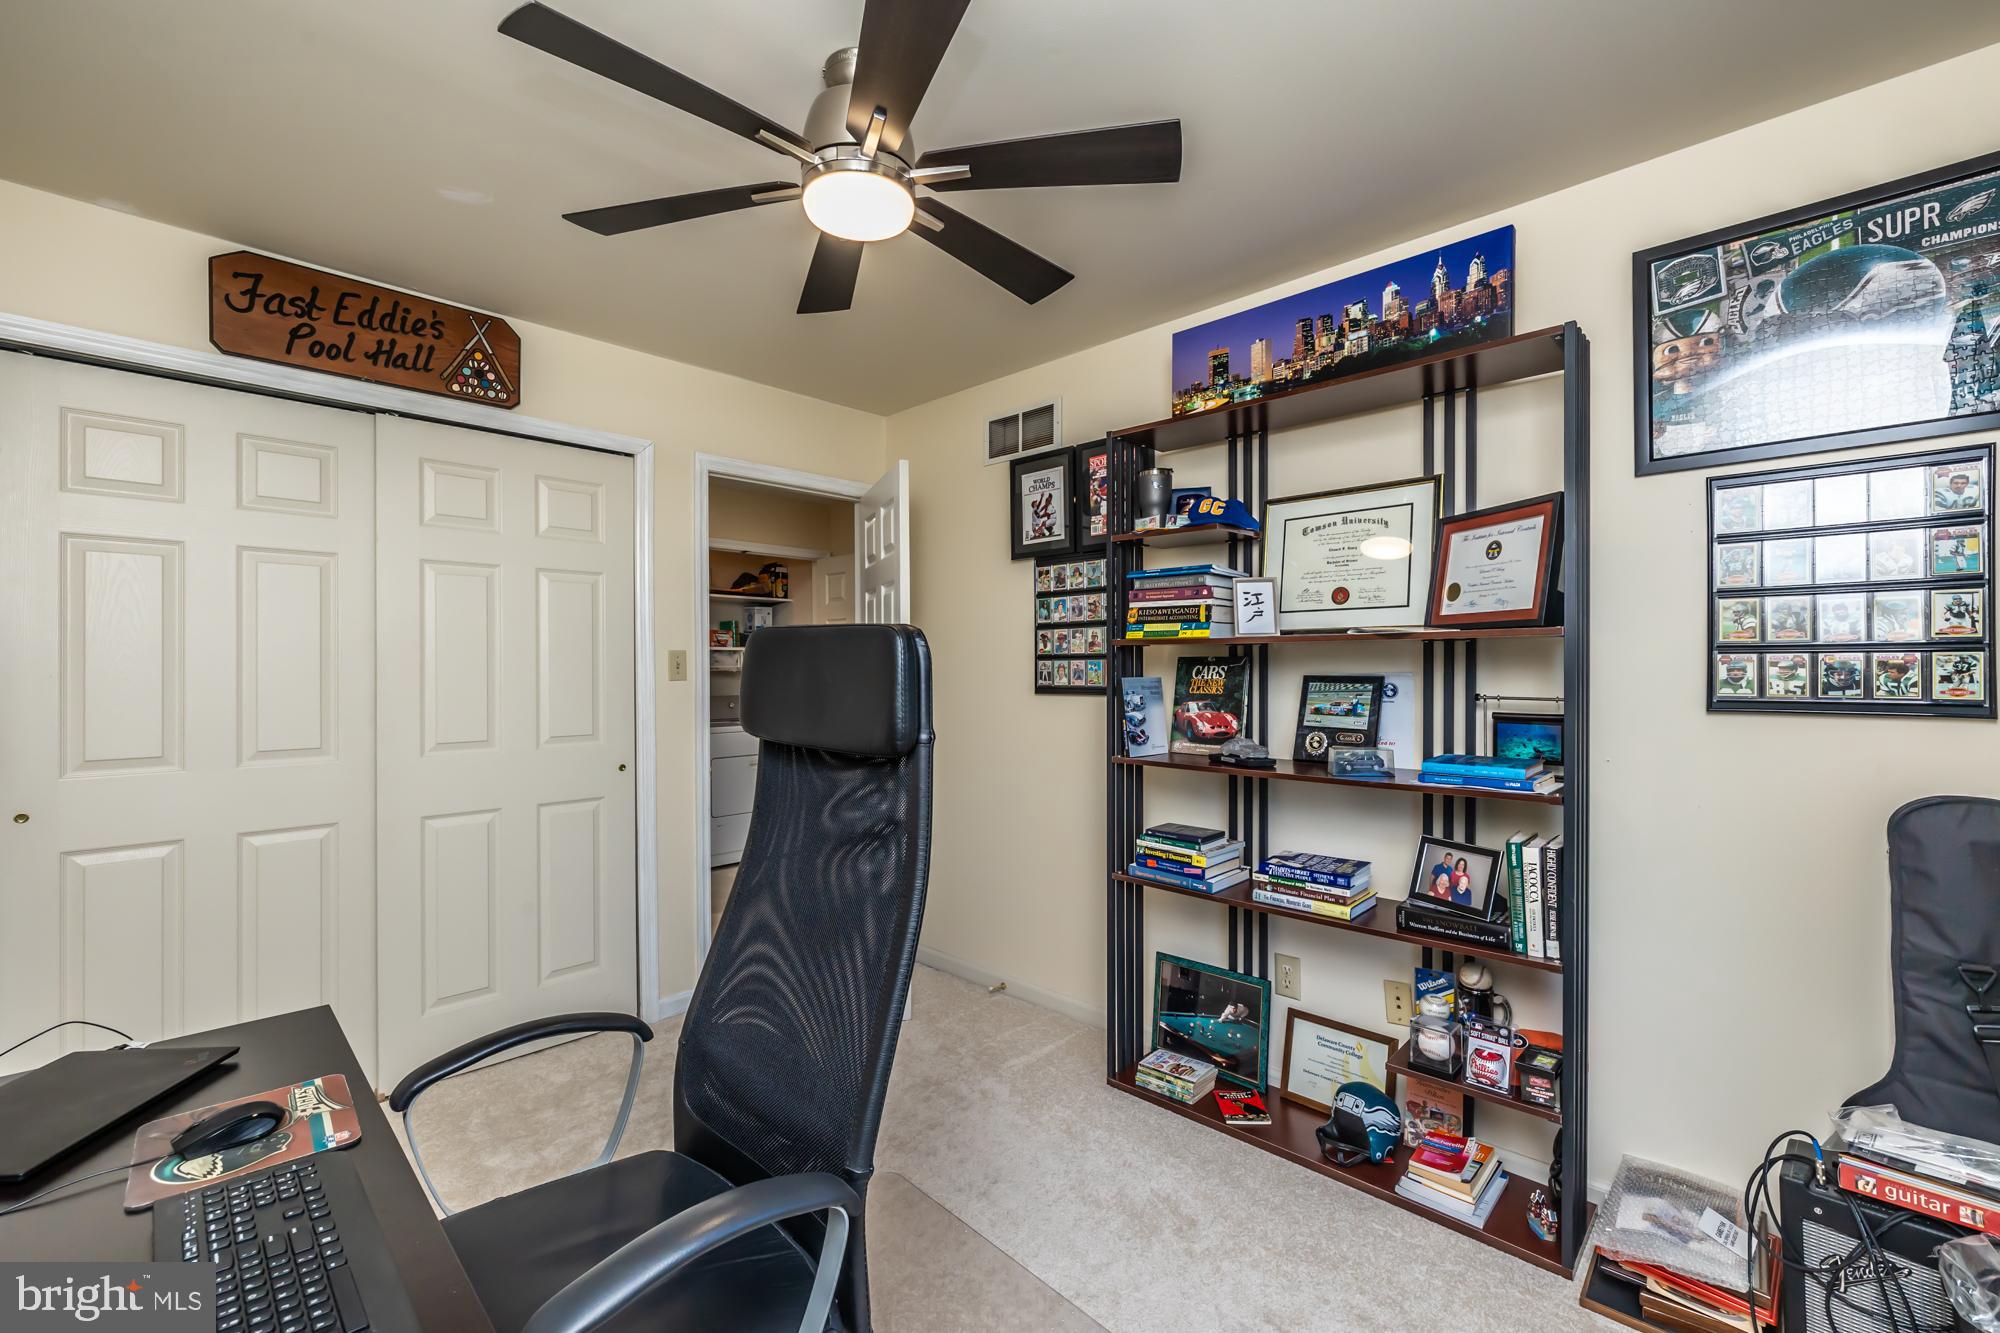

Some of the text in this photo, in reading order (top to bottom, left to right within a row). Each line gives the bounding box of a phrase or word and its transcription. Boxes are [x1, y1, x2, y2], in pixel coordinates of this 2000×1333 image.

[1788, 221, 1834, 242] PHILADELPHIA
[1867, 202, 1941, 244] SUPR
[1791, 219, 1854, 256] EAGLES
[1921, 221, 2000, 247] CHAMPION
[224, 271, 446, 340] Fast Eddie's
[285, 323, 436, 373] Pool Hall
[1029, 481, 1056, 493] CHAMPS
[1033, 476, 1051, 484] WORLD
[1198, 498, 1227, 516] GC
[1341, 516, 1389, 528] University
[1192, 665, 1228, 679] CARS
[1189, 686, 1225, 694] CLASSICS
[1145, 848, 1167, 859] Investing
[1269, 865, 1276, 875] 7
[1547, 848, 1557, 908] HIGHLY CONFIDENT
[1528, 862, 1538, 904] IACOCCA
[1300, 891, 1323, 900] Financial
[1409, 921, 1427, 929] Warren
[1458, 931, 1480, 939] Business
[1436, 919, 1478, 932] SNOWBALL
[1417, 977, 1447, 991] Wilson
[1316, 1035, 1356, 1051] Delaware County
[1470, 1030, 1481, 1038] SOFT
[1317, 1041, 1363, 1060] Community College
[1471, 1057, 1498, 1075] Phillies
[1885, 1185, 1951, 1215] guitar
